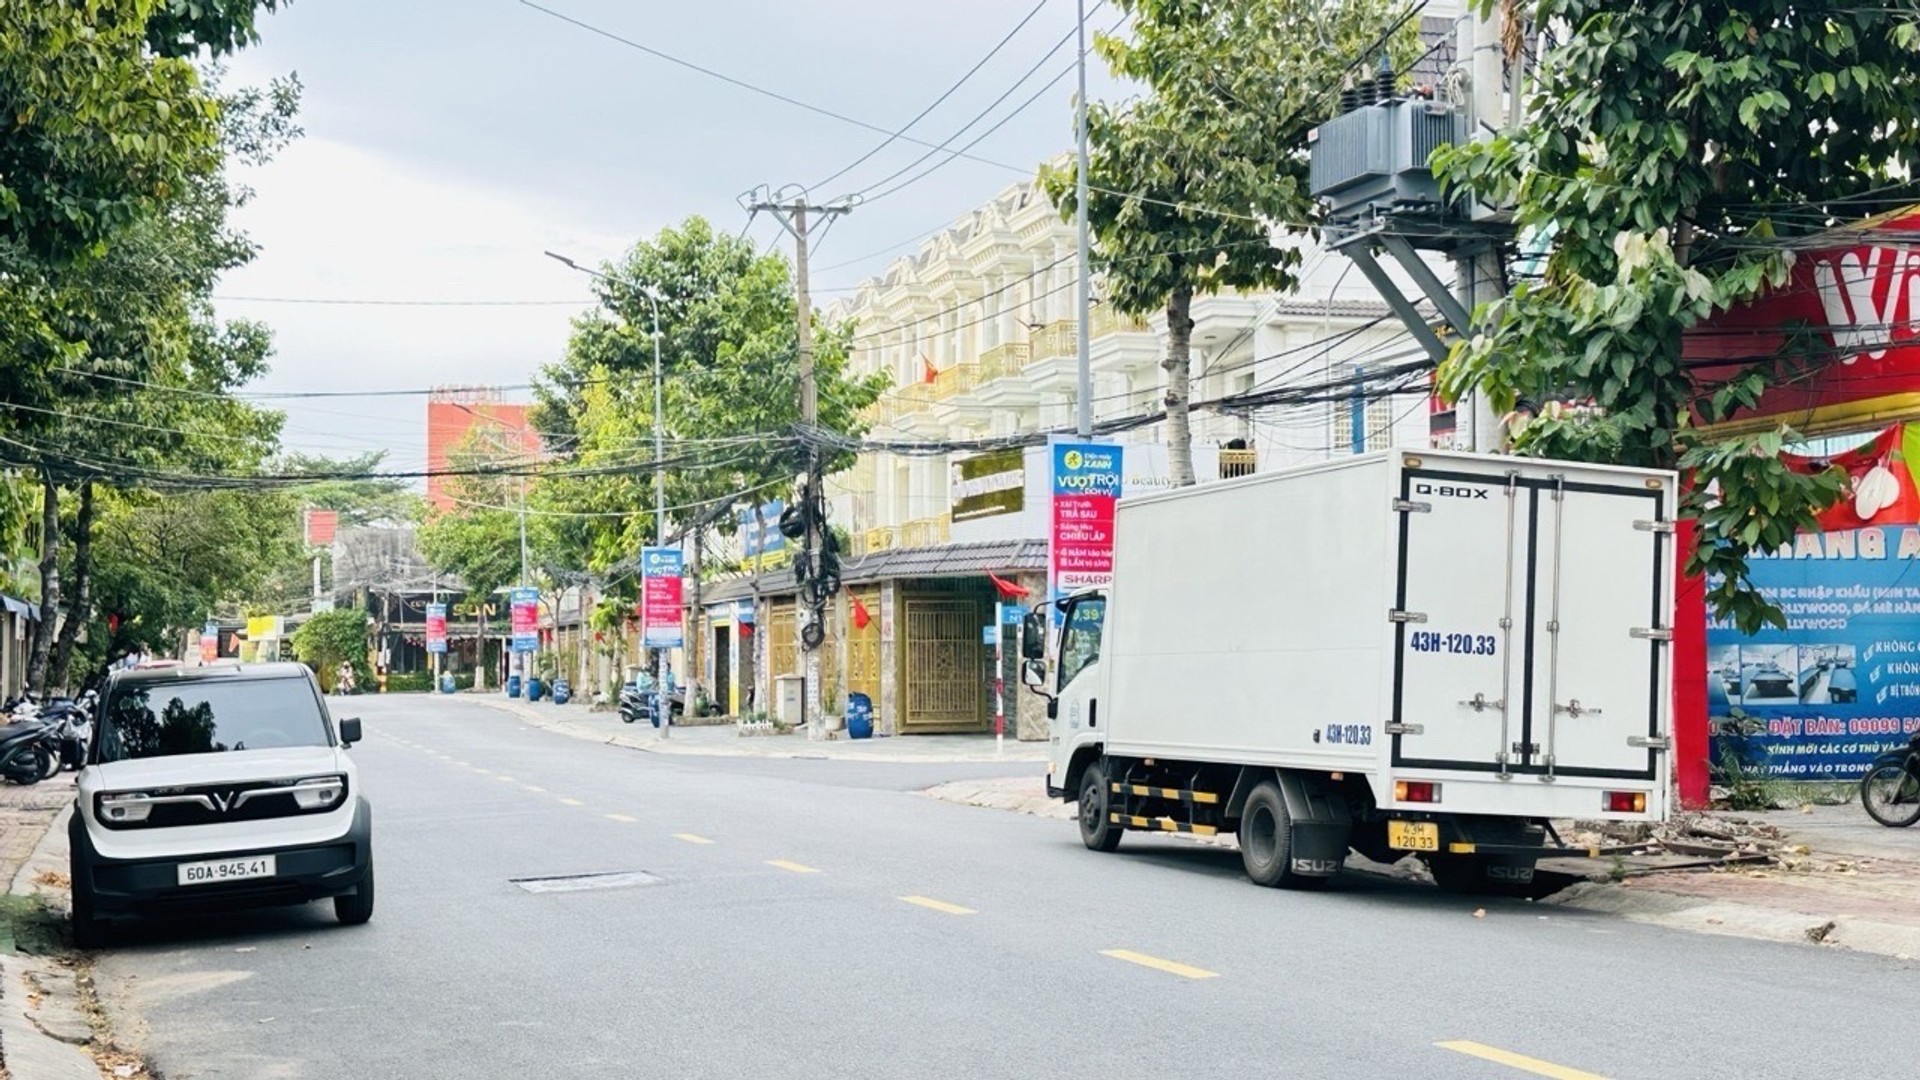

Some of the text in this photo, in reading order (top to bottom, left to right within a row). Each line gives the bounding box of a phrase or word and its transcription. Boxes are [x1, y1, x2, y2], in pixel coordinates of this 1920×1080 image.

[1083, 459, 1112, 470] XANH
[1064, 574, 1112, 585] SHARP
[1777, 602, 1851, 615] OLLYWOOD,
[1410, 631, 1496, 656] 43H-120.33
[1887, 660, 1920, 674] KHÔN
[1768, 715, 1803, 739] ĐẶT
[1848, 716, 1901, 735] 09099
[1325, 724, 1371, 746] 43H-120.33
[1834, 762, 1874, 773] TRONG
[1403, 823, 1425, 835] 43H
[186, 860, 267, 881] 60A-945.41
[1291, 857, 1338, 873] ISUZ
